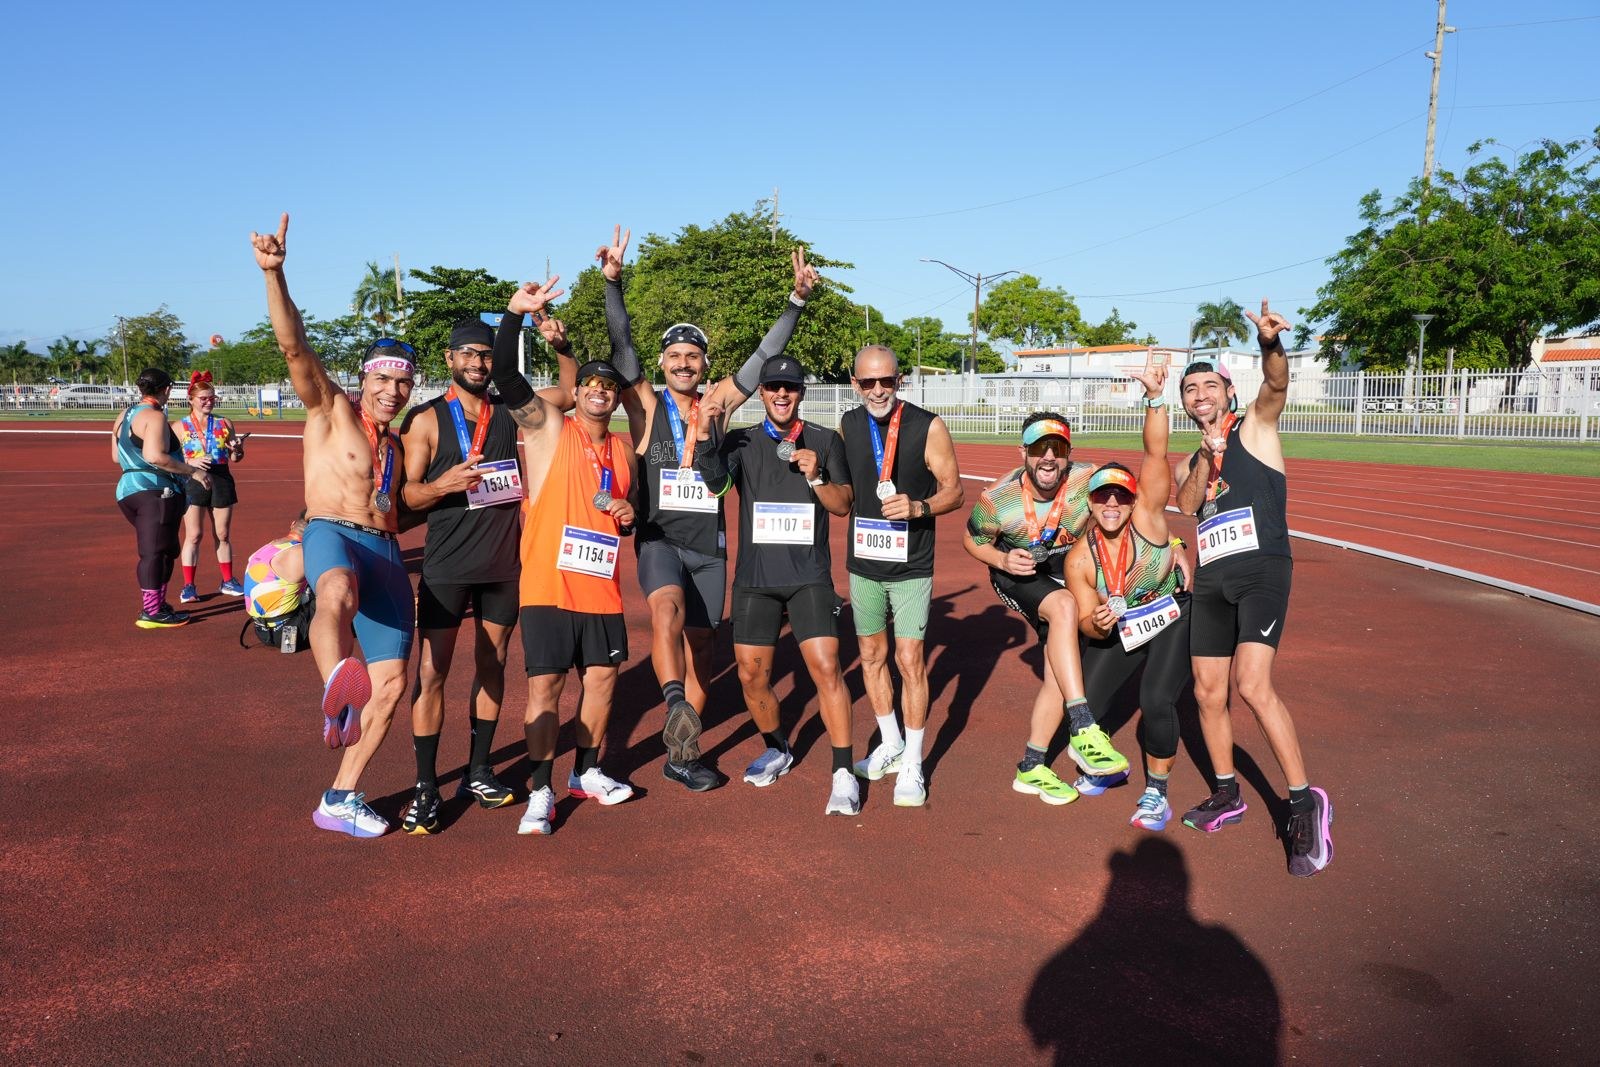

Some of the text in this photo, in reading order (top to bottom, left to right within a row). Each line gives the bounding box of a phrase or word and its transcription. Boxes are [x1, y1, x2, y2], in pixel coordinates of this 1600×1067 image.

[483, 475, 510, 493] 1534
[677, 485, 703, 500] 1073
[362, 526, 381, 536] SPORT
[771, 518, 797, 532] 1107
[867, 533, 892, 549] 0038
[1209, 526, 1237, 548] 0175
[578, 544, 604, 563] 1154
[1136, 614, 1166, 635] 1048
